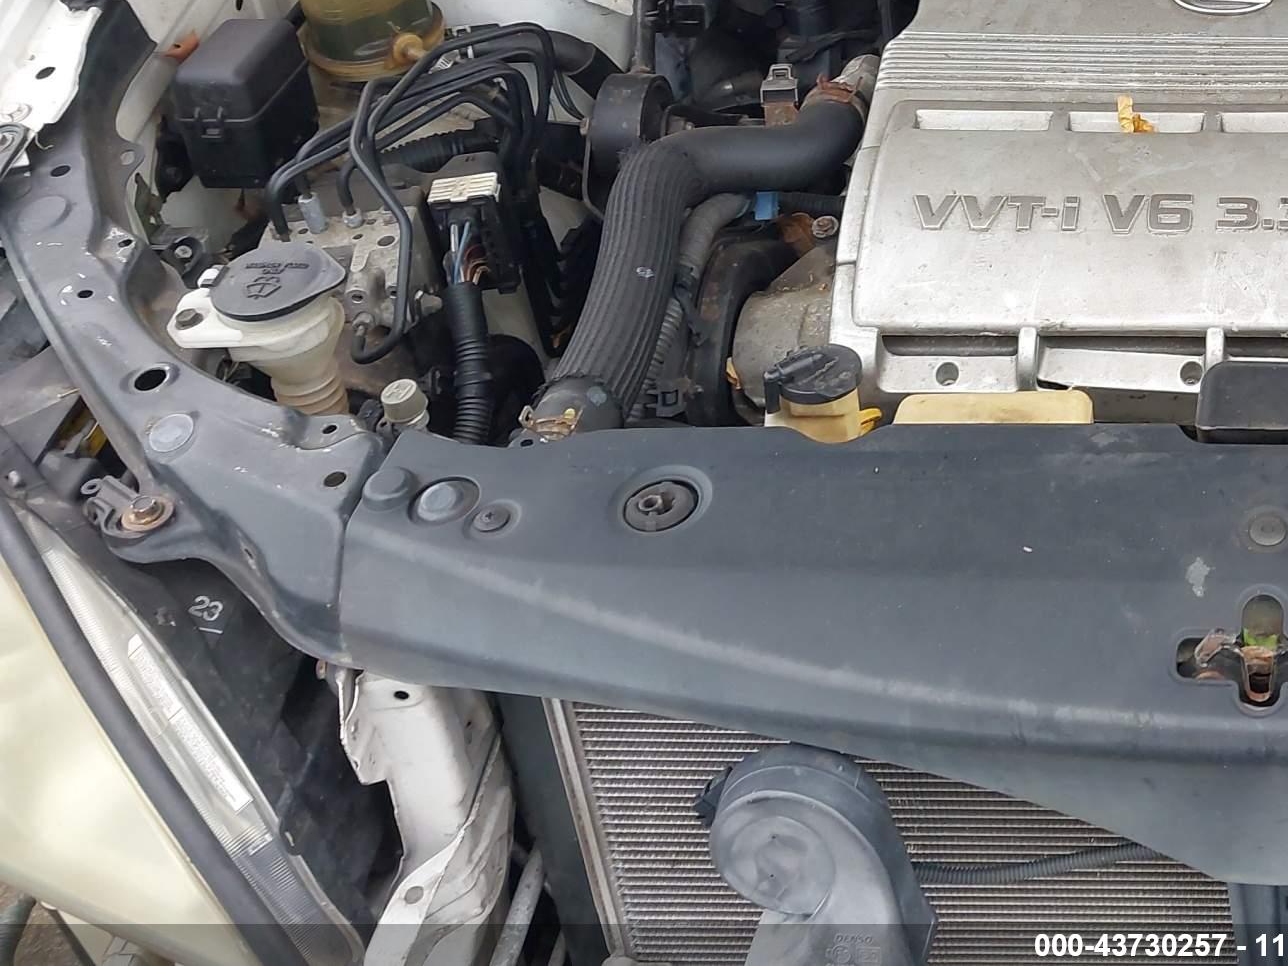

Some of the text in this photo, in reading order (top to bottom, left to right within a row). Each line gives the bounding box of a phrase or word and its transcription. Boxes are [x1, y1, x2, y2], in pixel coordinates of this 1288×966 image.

[913, 194, 1080, 231] VVT-i
[1102, 193, 1194, 233] V6
[188, 595, 224, 621] 23
